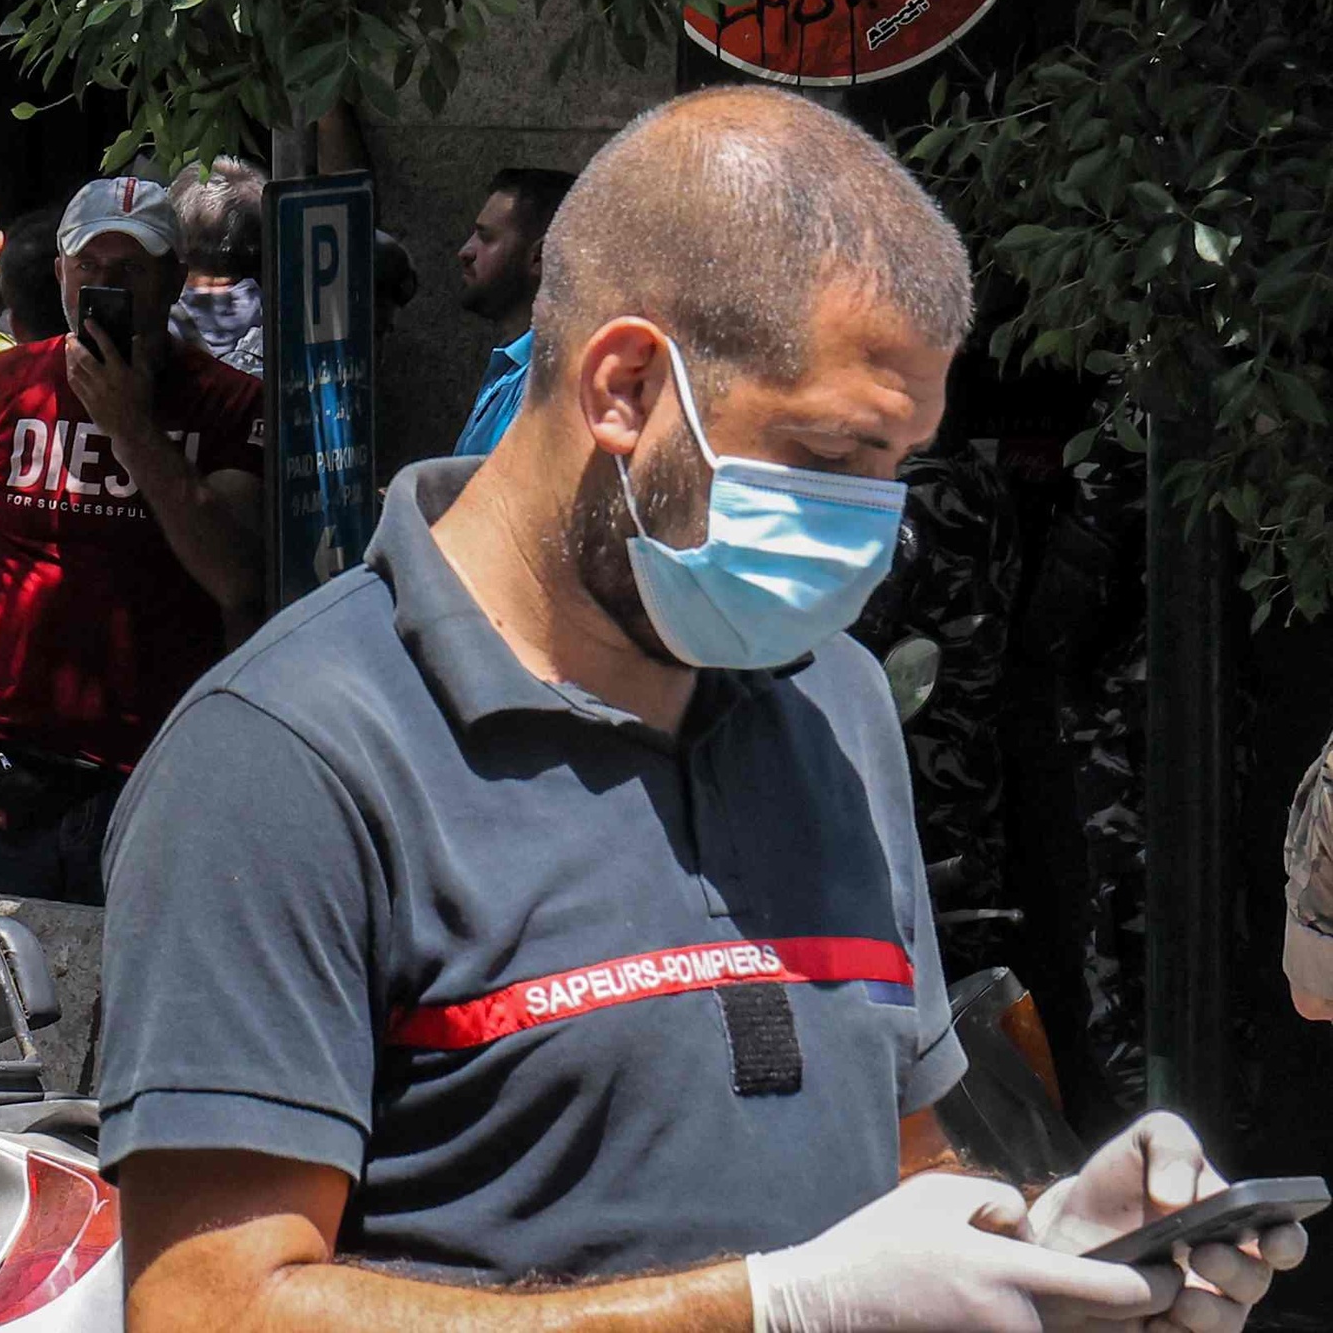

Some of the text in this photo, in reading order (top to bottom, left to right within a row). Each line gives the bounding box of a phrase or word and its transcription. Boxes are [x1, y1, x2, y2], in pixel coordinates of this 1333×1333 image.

[311, 224, 340, 325] P
[6, 418, 201, 498] DIES
[316, 443, 369, 474] PARKING
[6, 494, 147, 519] FOR SUCCESSFUL
[525, 945, 783, 1016] SAPEURS-POMPIERS
